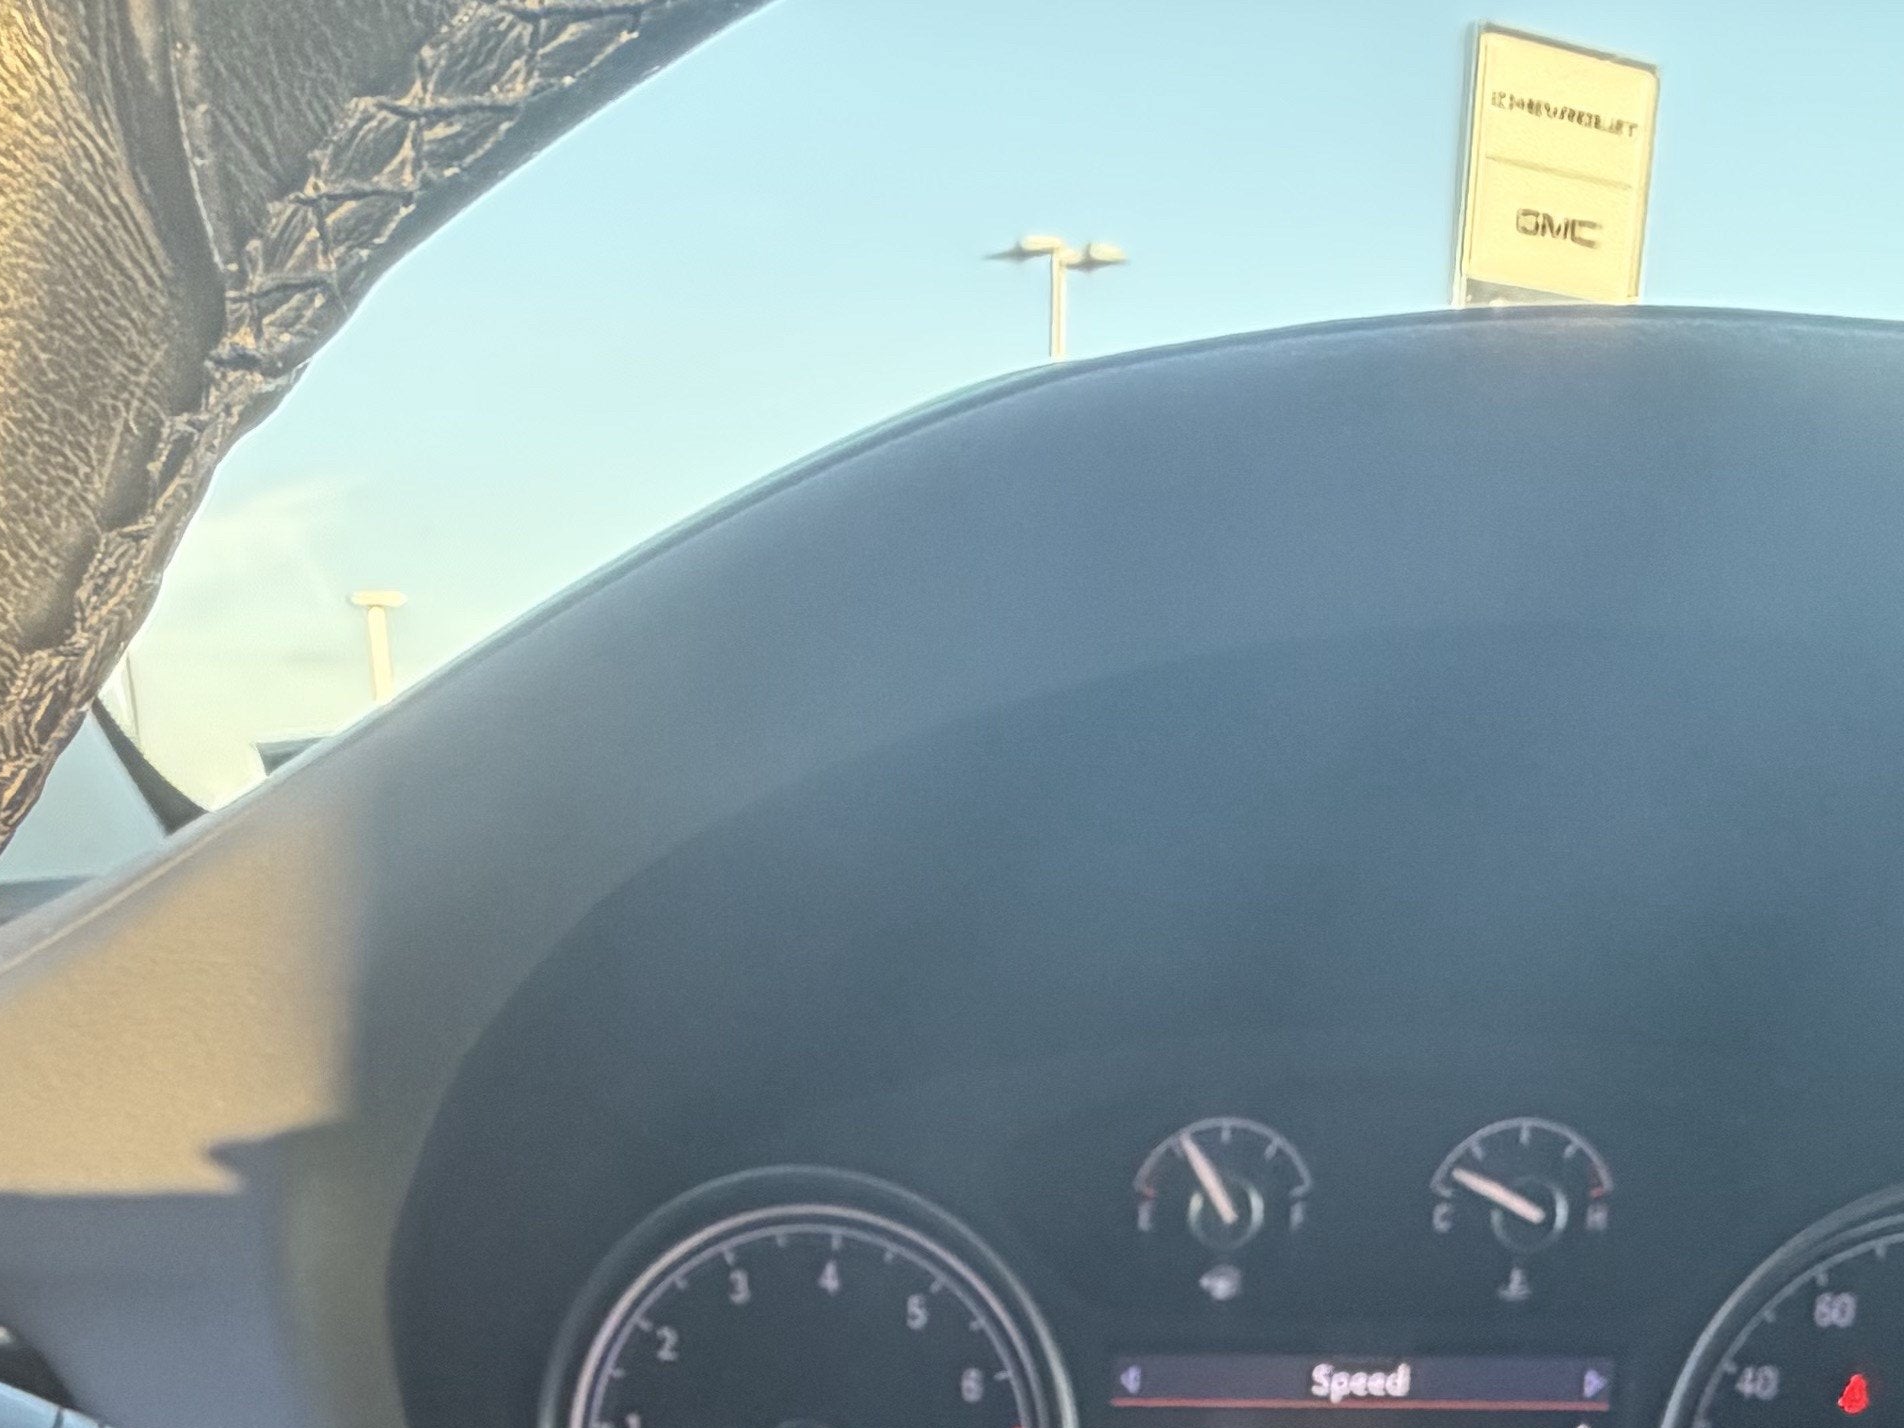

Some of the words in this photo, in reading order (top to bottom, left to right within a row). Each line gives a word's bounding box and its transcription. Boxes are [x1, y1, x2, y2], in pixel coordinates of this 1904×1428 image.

[1515, 207, 1603, 249] GMC
[730, 1271, 751, 1304] 3
[818, 1261, 841, 1295] 4
[906, 1295, 929, 1330] 5
[1813, 1292, 1857, 1328] 60
[656, 1327, 679, 1361] 2
[961, 1367, 984, 1402] 6
[1311, 1362, 1411, 1404] Speed
[1735, 1365, 1779, 1399] 40
